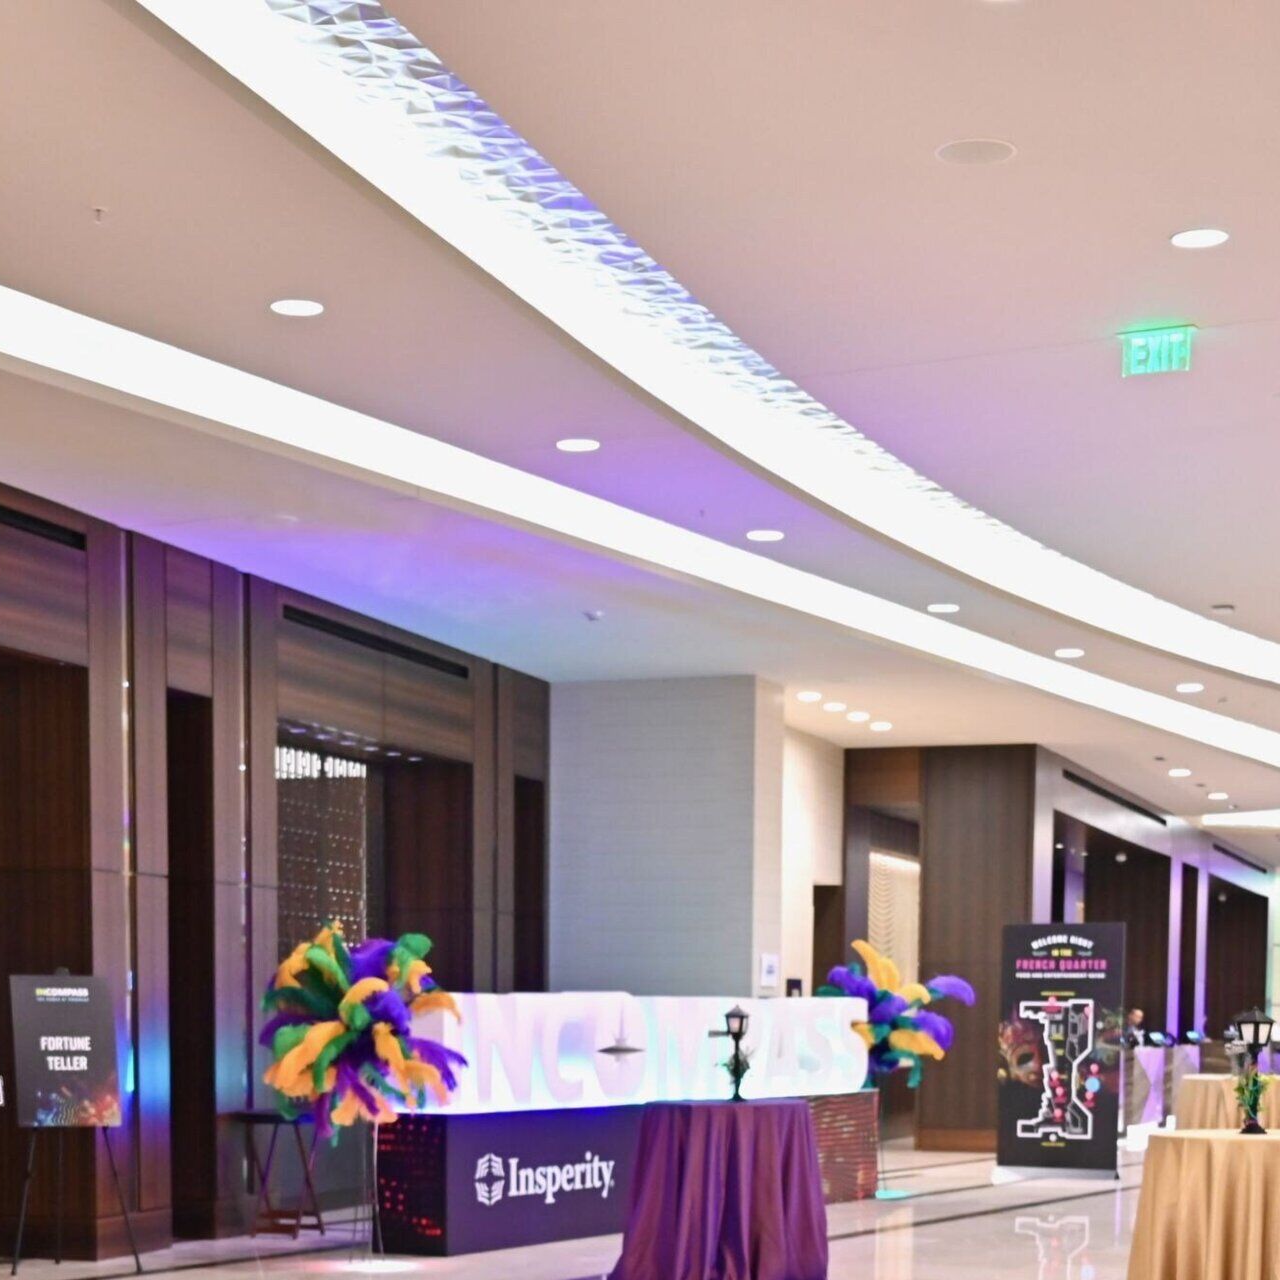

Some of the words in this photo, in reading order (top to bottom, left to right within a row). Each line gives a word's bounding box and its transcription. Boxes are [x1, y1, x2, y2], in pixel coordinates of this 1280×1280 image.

[1131, 333, 1184, 374] EXIT
[1016, 960, 1055, 970] FRENCH
[1060, 959, 1107, 971] QUARTER
[40, 1036, 91, 1051] FORTUNE
[47, 1056, 88, 1071] TELLER
[508, 1151, 615, 1204] Insperity
